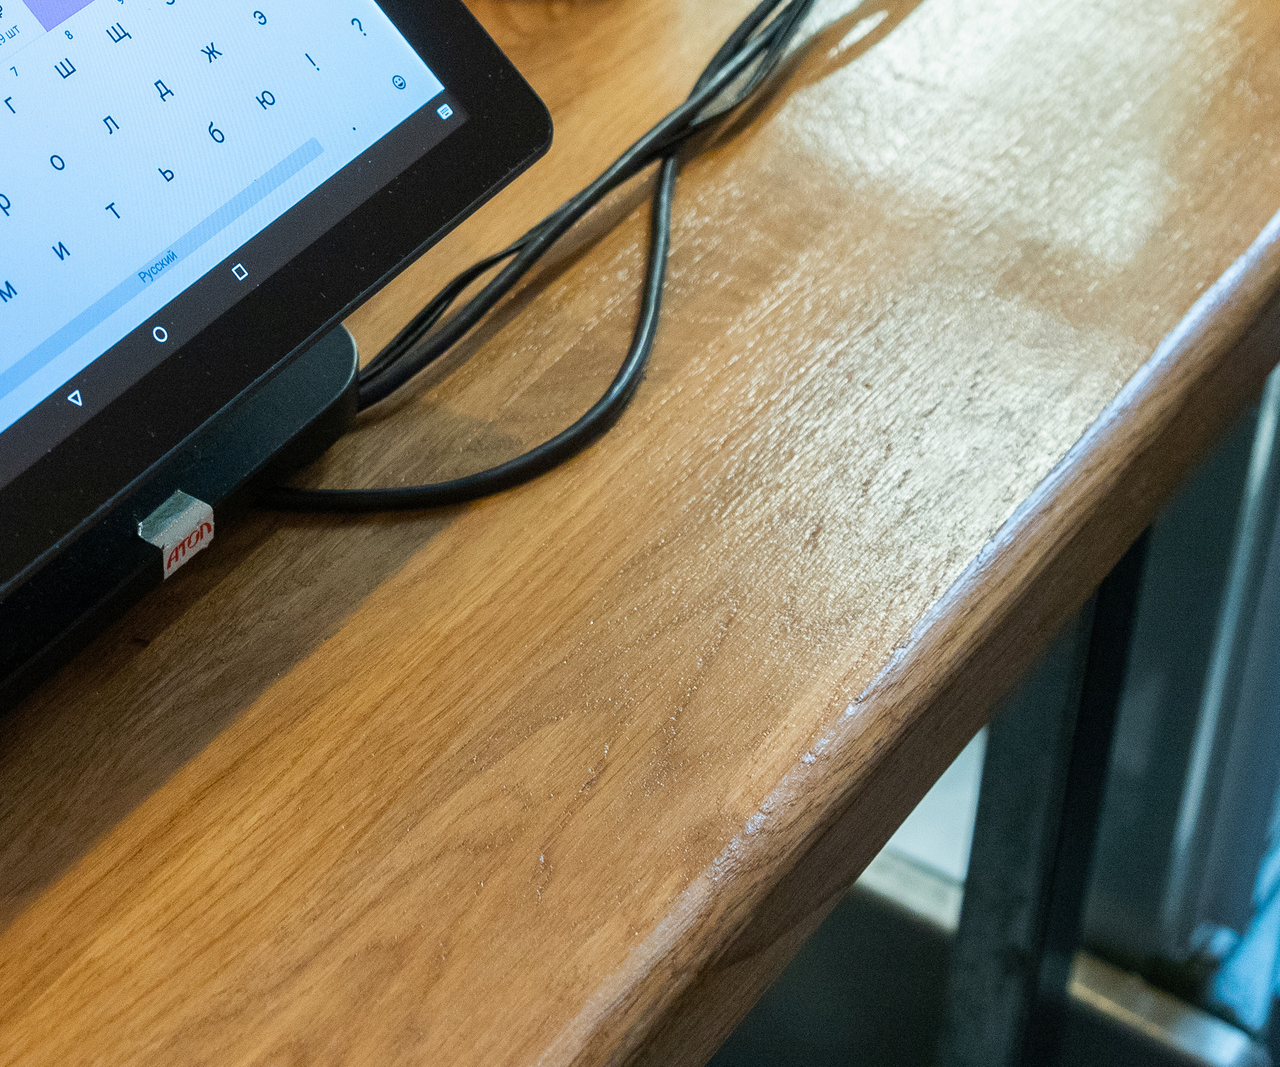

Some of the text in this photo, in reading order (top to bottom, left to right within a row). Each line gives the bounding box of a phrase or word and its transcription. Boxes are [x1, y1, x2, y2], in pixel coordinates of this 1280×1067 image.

[252, 10, 268, 26] э
[350, 17, 367, 37] ?
[5, 24, 21, 40] шт
[64, 29, 74, 40] 8
[105, 22, 133, 44] щ
[200, 41, 223, 64] ж
[9, 65, 19, 77] 7
[53, 57, 77, 80] ш
[153, 79, 175, 103] д
[255, 90, 276, 111] ю
[3, 96, 17, 115] г
[102, 115, 120, 135] л
[208, 120, 225, 144] б
[49, 154, 66, 171] о
[157, 167, 175, 183] ь
[104, 201, 121, 220] т
[51, 241, 71, 261] и
[137, 249, 178, 284] Русский
